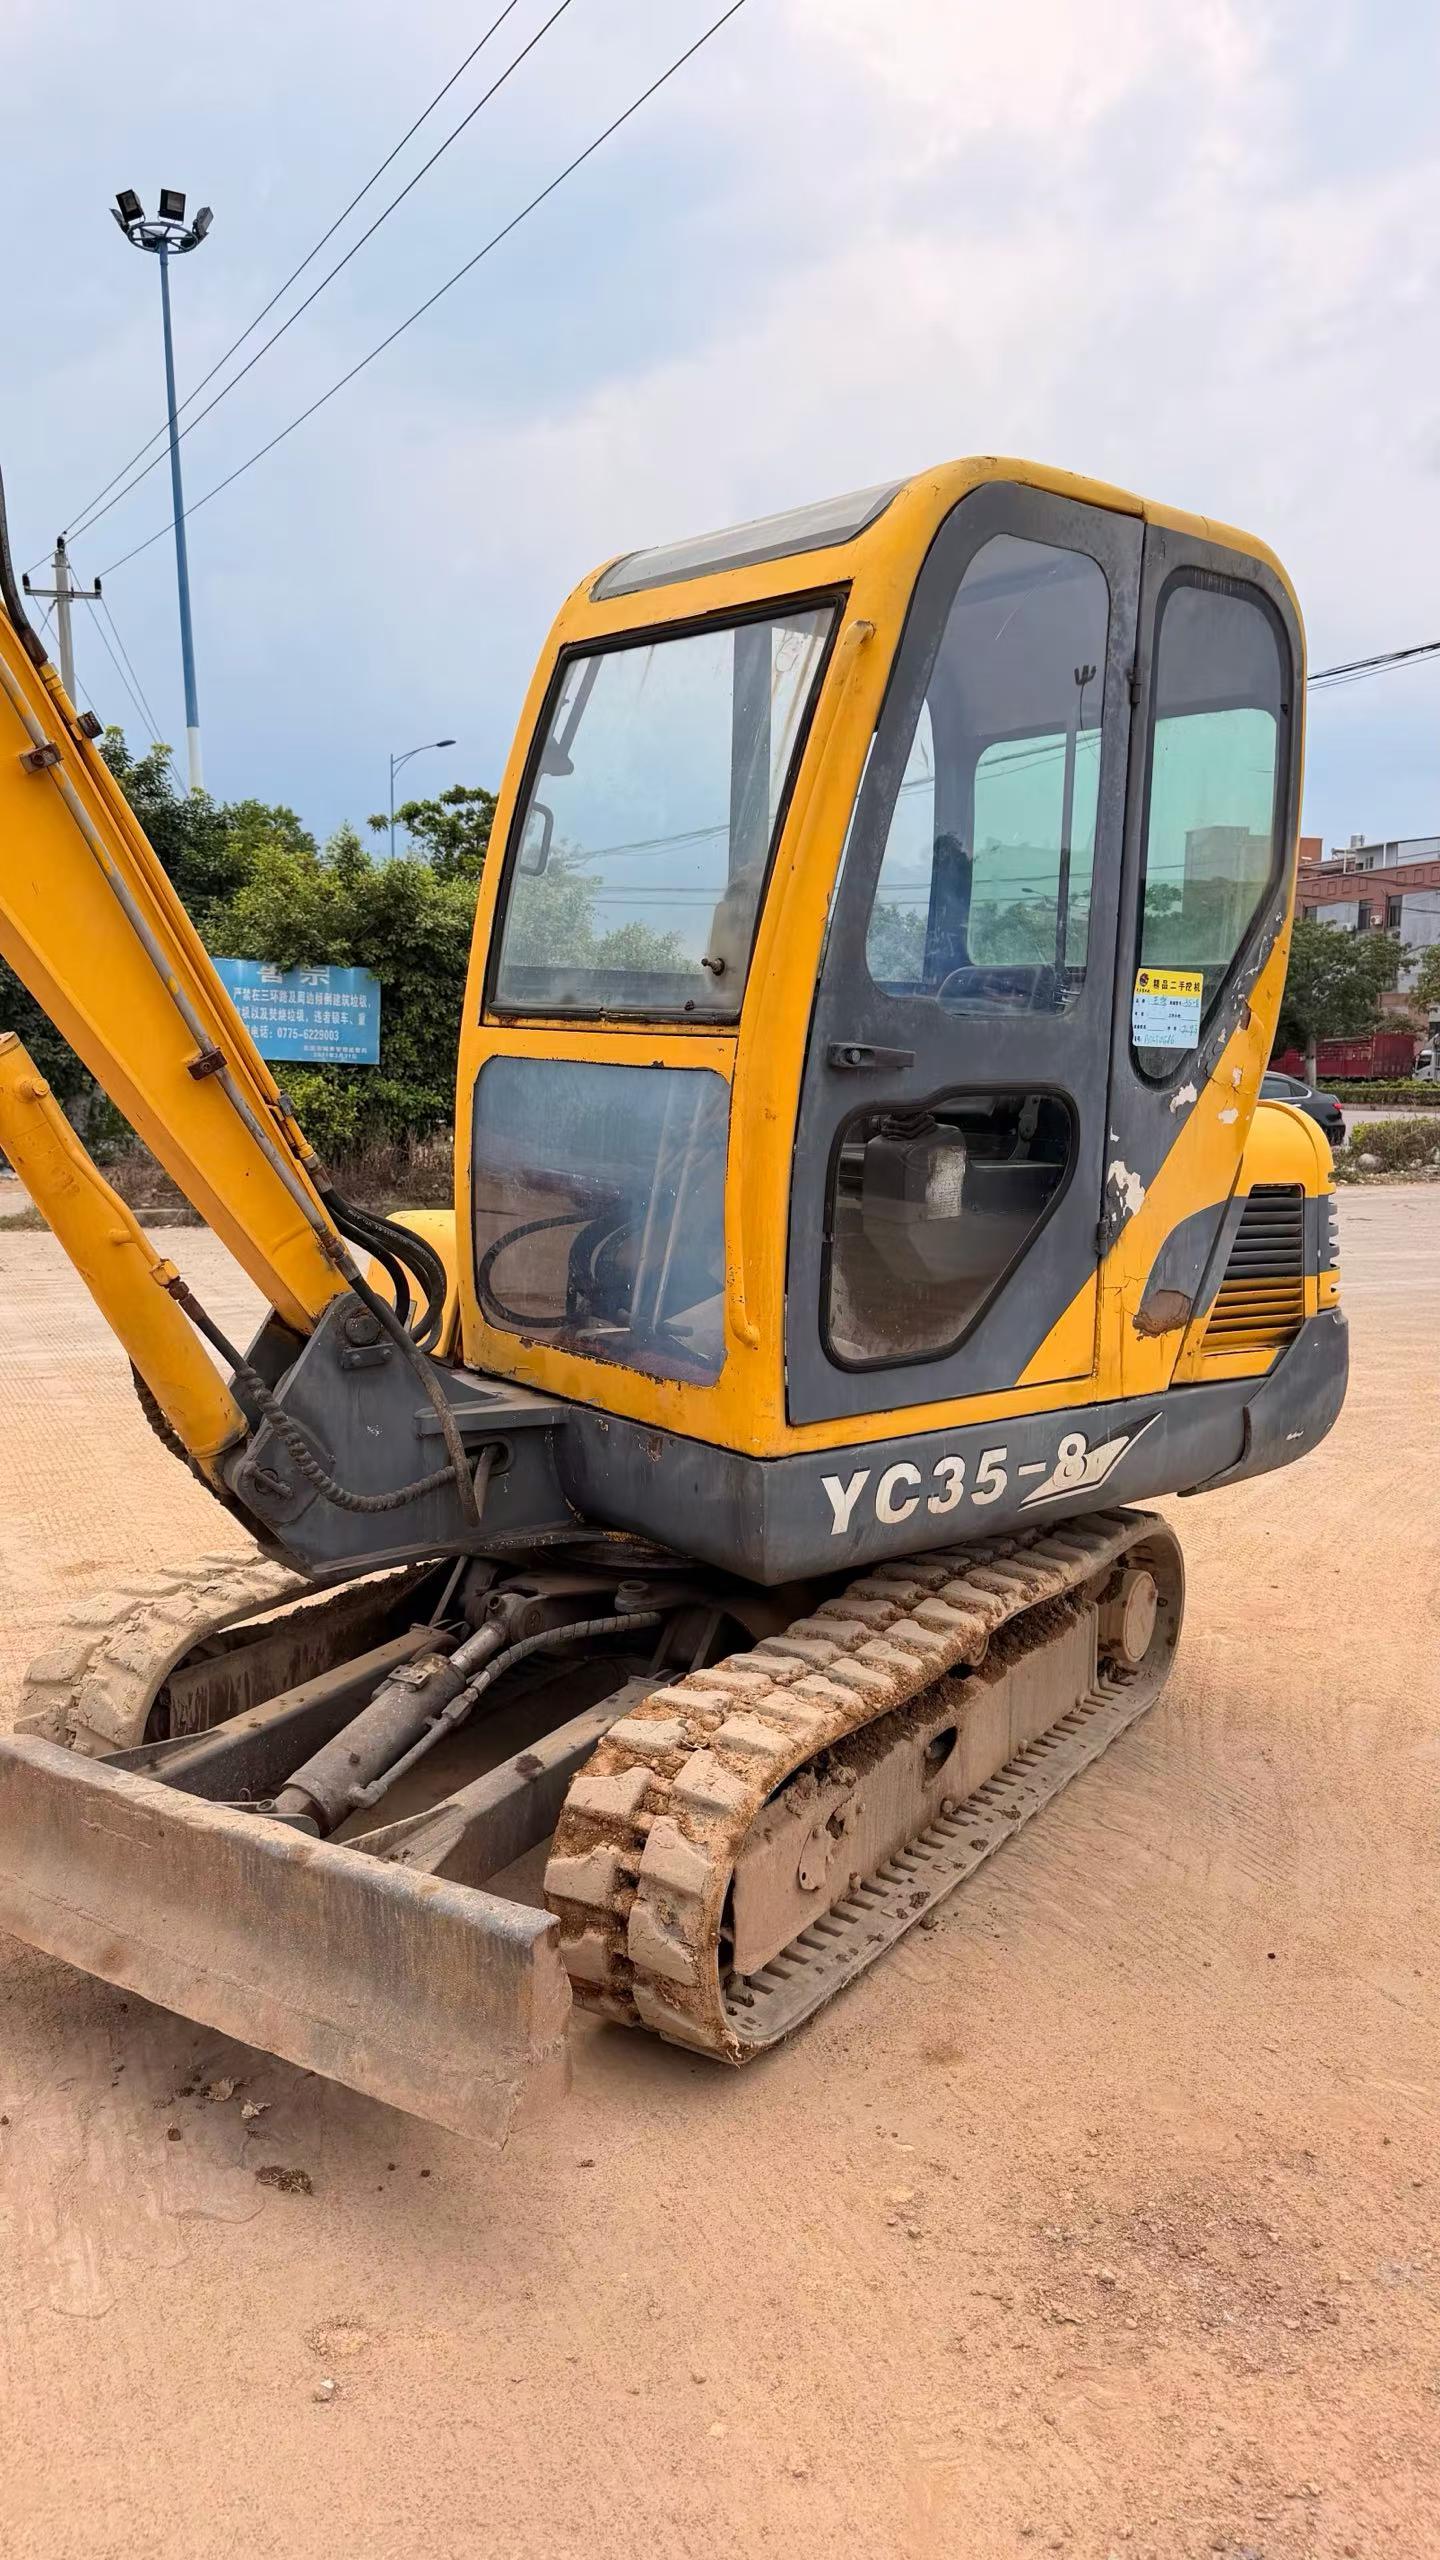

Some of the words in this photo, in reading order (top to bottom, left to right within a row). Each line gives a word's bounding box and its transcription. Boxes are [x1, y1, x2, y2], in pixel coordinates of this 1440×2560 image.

[1153, 979, 1201, 993] 精品二手挖机
[820, 1432, 1090, 1536] YC35-8
